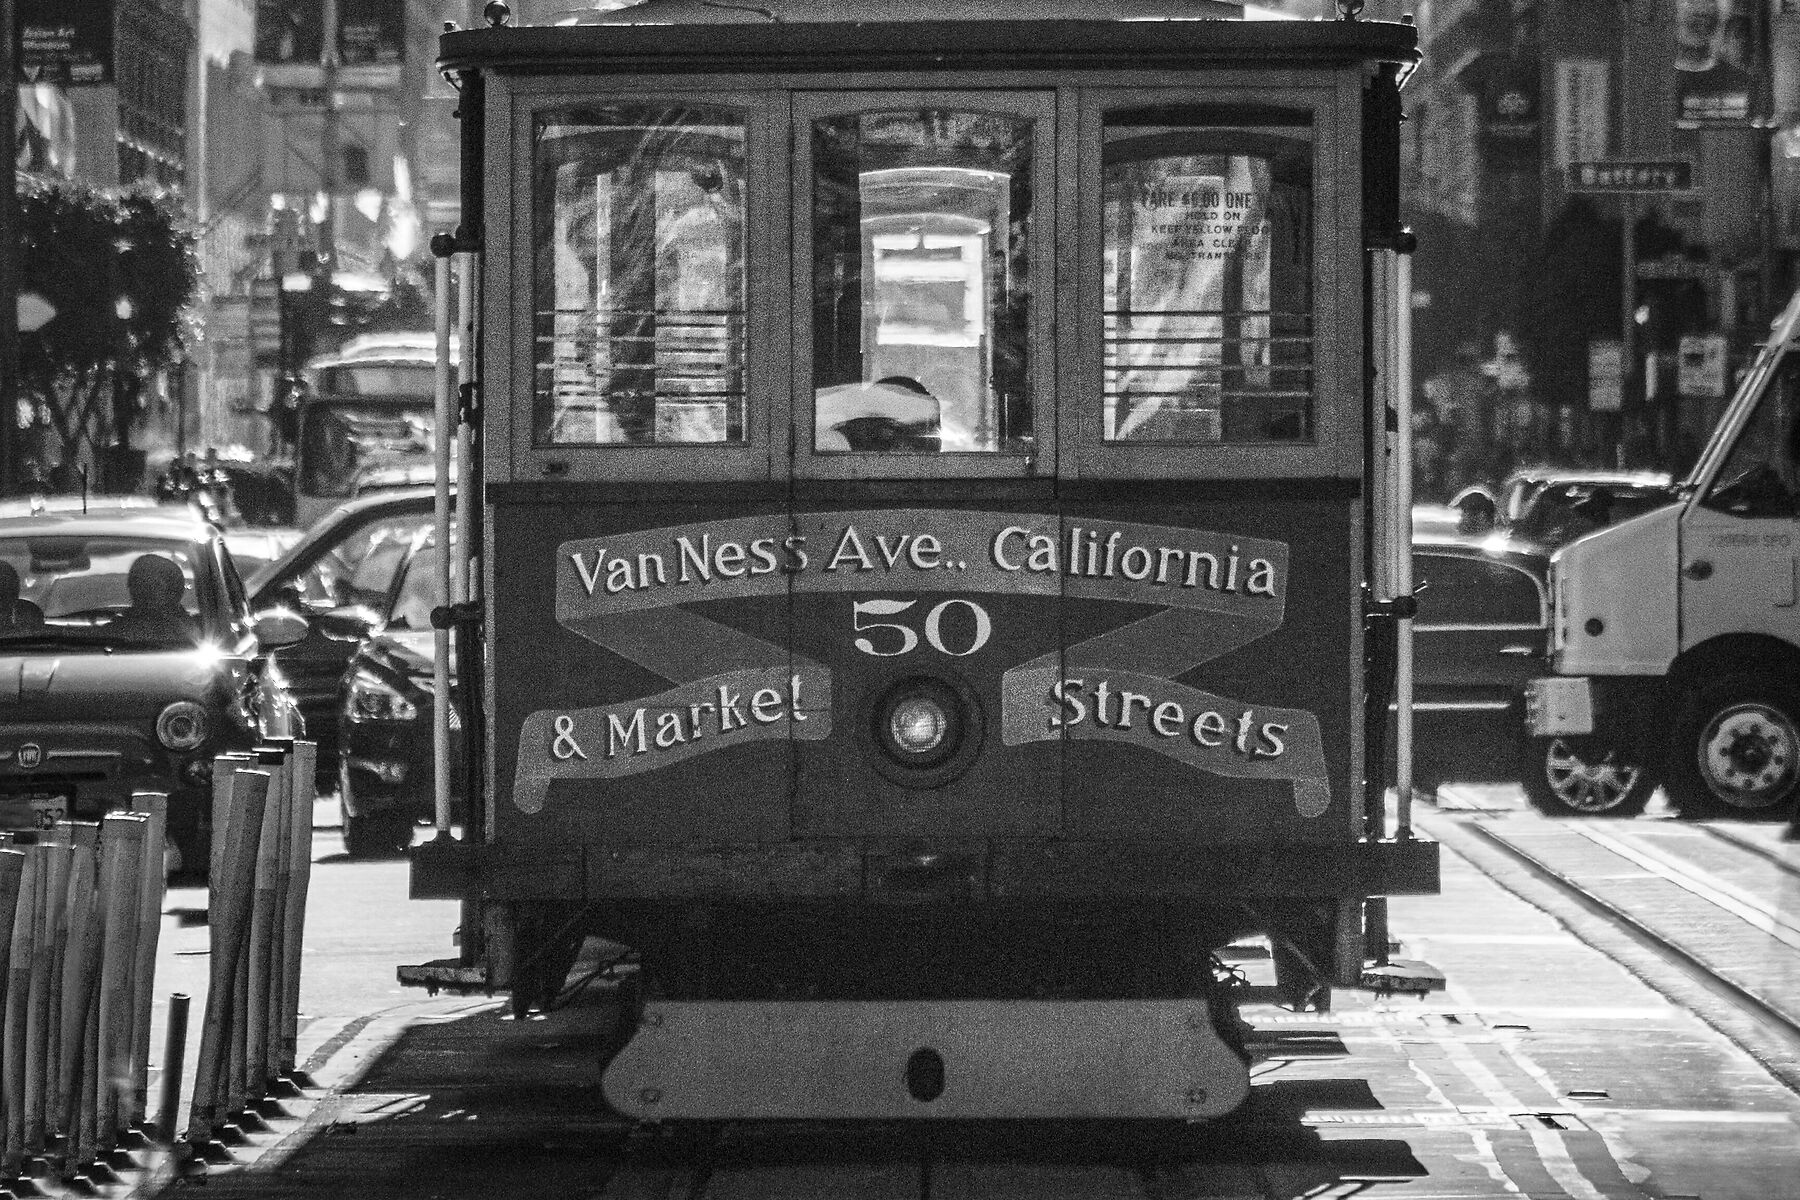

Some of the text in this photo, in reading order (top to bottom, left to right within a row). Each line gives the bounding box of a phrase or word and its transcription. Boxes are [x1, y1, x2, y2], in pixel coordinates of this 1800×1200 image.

[1223, 211, 1241, 221] ON
[1226, 191, 1253, 209] ONE
[571, 548, 667, 596] Van
[676, 533, 808, 582] Ness
[993, 526, 1277, 598] California
[853, 600, 992, 656] 50
[552, 673, 808, 760] & Market
[1050, 678, 1290, 758] Streets
